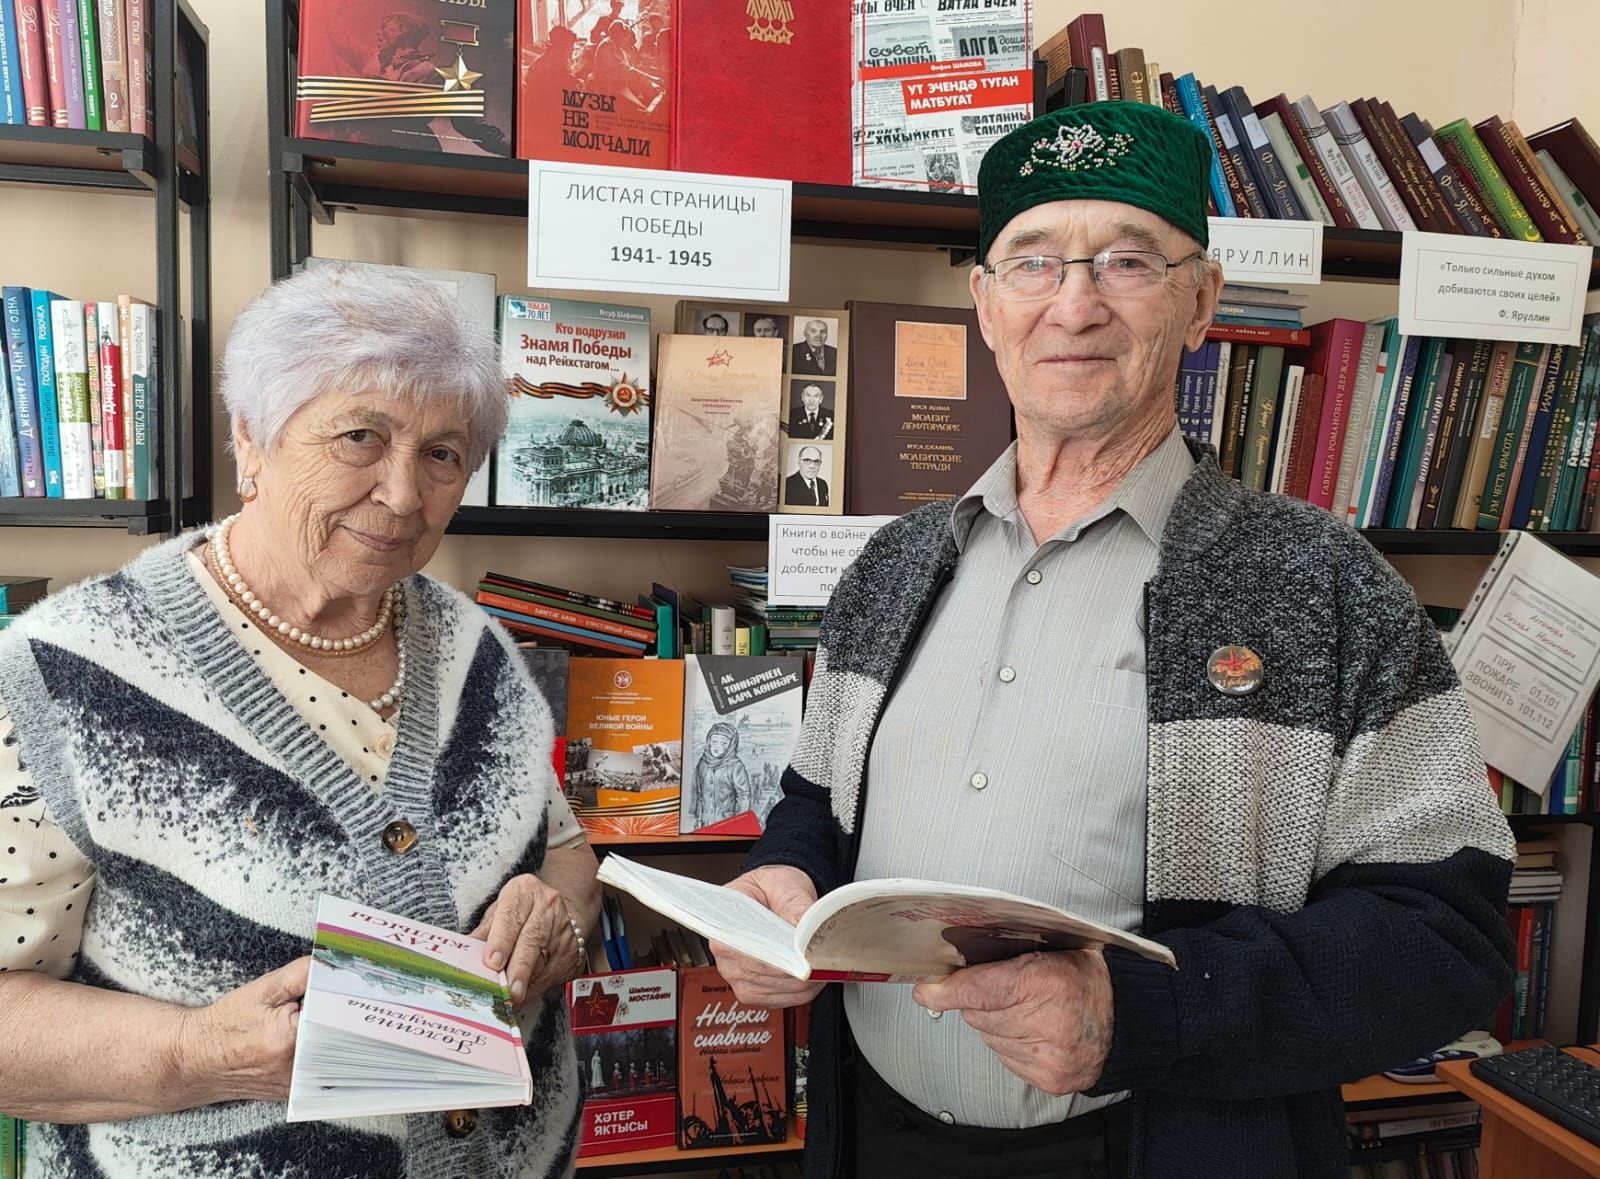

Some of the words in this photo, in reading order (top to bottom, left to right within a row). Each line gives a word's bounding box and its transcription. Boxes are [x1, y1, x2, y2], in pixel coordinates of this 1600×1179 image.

[959, 36, 998, 57] АЛГА
[908, 84, 923, 95] УТ
[929, 80, 978, 94] ЭЧЕНДӘ
[981, 76, 1019, 89] ТУГАН
[110, 92, 119, 109] 2
[562, 89, 616, 113] МУЗЫ
[911, 94, 973, 110] МАТБУГАТ
[562, 110, 589, 129] НЕ
[562, 131, 652, 157] МОЛЧАЛИ
[566, 183, 643, 205] ЛИСТАЯ
[650, 190, 756, 214] СТРАНИЦЫ
[621, 216, 703, 239] ПОБЕДЫ
[610, 246, 662, 264] 1941-
[668, 250, 712, 267] 1945
[1212, 247, 1309, 267] ЯРУЛЛИН
[1440, 261, 1480, 276] «Только
[1482, 265, 1524, 278] сильные
[1525, 269, 1556, 283] духом
[1438, 283, 1497, 298] добиваются
[1499, 289, 1525, 299] своих
[1527, 289, 1560, 304] целей»
[7, 296, 19, 323] ОДНА
[528, 310, 537, 319] 70
[537, 311, 549, 320] ЛЕТ
[1498, 309, 1509, 321] Ф.
[1511, 310, 1550, 324] Яруллин
[10, 327, 20, 339] НЕ
[555, 322, 573, 335] Кто
[575, 326, 626, 340] водрузил
[521, 334, 569, 353] Знамя
[573, 338, 632, 359] Победы
[526, 356, 547, 367] над
[1356, 332, 1376, 386] ГУМИЛЕВ
[1244, 359, 1254, 392] Никогда
[101, 365, 115, 413] Джером
[134, 383, 144, 409] ВЕТЕР
[1242, 394, 1249, 404] не
[1448, 387, 1459, 411] АФЗАЛ
[1320, 453, 1334, 495] ГАВРИЛА
[1327, 392, 1344, 451] РОМАНОВИЧ
[1336, 337, 1354, 390] ДЕРЖАВИН
[1388, 420, 1403, 461] АНАТОЛИЙ
[1397, 375, 1413, 415] ПАШИН
[1428, 394, 1446, 424] АЙРАТ
[134, 410, 145, 445] СУДЬБЫ
[1236, 405, 1247, 437] угаснет
[1340, 390, 1367, 470] НИКОЛАЕВИЧ
[900, 452, 962, 462] МОАБИТСКИЕ
[1414, 430, 1438, 482] АРСЛАНОВ
[1497, 431, 1515, 469] КРАСОТА
[910, 462, 951, 471] ТЕТРАДИ
[1336, 476, 1350, 498] ЛЕВ
[782, 527, 817, 539] Книги
[820, 531, 827, 539] о
[831, 528, 866, 540] войне
[792, 545, 828, 557] чтобы
[832, 549, 846, 557] не
[781, 563, 837, 575] доблести
[819, 584, 835, 592] по
[1491, 653, 1516, 674] ПРИ
[720, 672, 735, 685] АК
[1473, 659, 1520, 692] ПОЖАРЕ
[727, 690, 753, 706] КАРА
[752, 672, 799, 697] КӨННӘРЕ
[1464, 670, 1516, 706] ЗВОНИТЬ
[589, 722, 624, 730] ВЕЛИКОЙ
[596, 714, 620, 722] ЮНЫЕ
[622, 714, 647, 722] ГЕРОИ
[383, 933, 443, 955] ТАУ
[629, 992, 671, 1002] МОСТАФИН
[348, 998, 488, 1047] Галимуллина
[696, 1001, 769, 1027] Навеки
[694, 1023, 772, 1048] славные
[594, 1110, 635, 1124] ХӘТЕР
[594, 1121, 648, 1136] ЯКТЫСЫ
